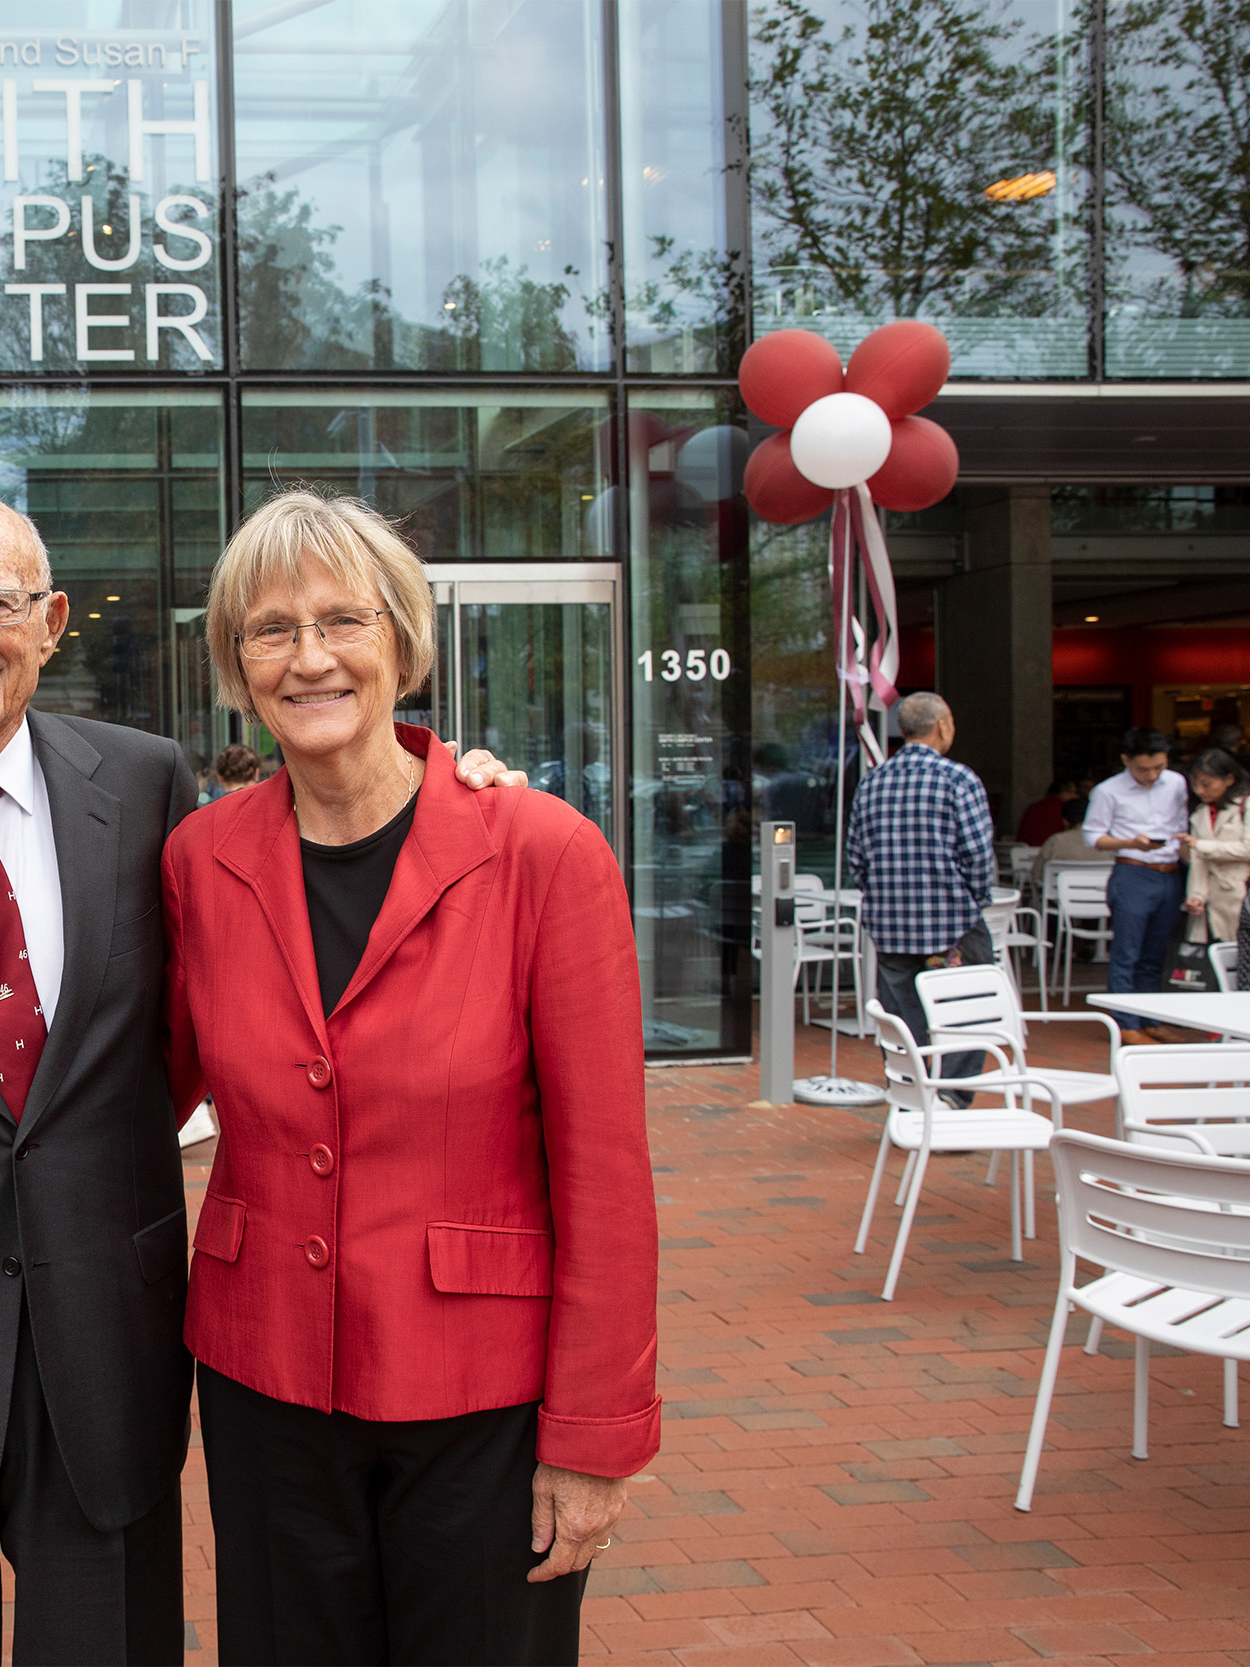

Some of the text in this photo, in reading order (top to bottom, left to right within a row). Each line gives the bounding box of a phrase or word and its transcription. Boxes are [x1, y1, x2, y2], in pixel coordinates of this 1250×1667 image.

[55, 34, 166, 66] Susan
[637, 648, 731, 682] 1350
[7, 891, 16, 901] H
[18, 949, 28, 960] 46
[34, 1005, 43, 1016] H
[15, 1038, 25, 1051] H
